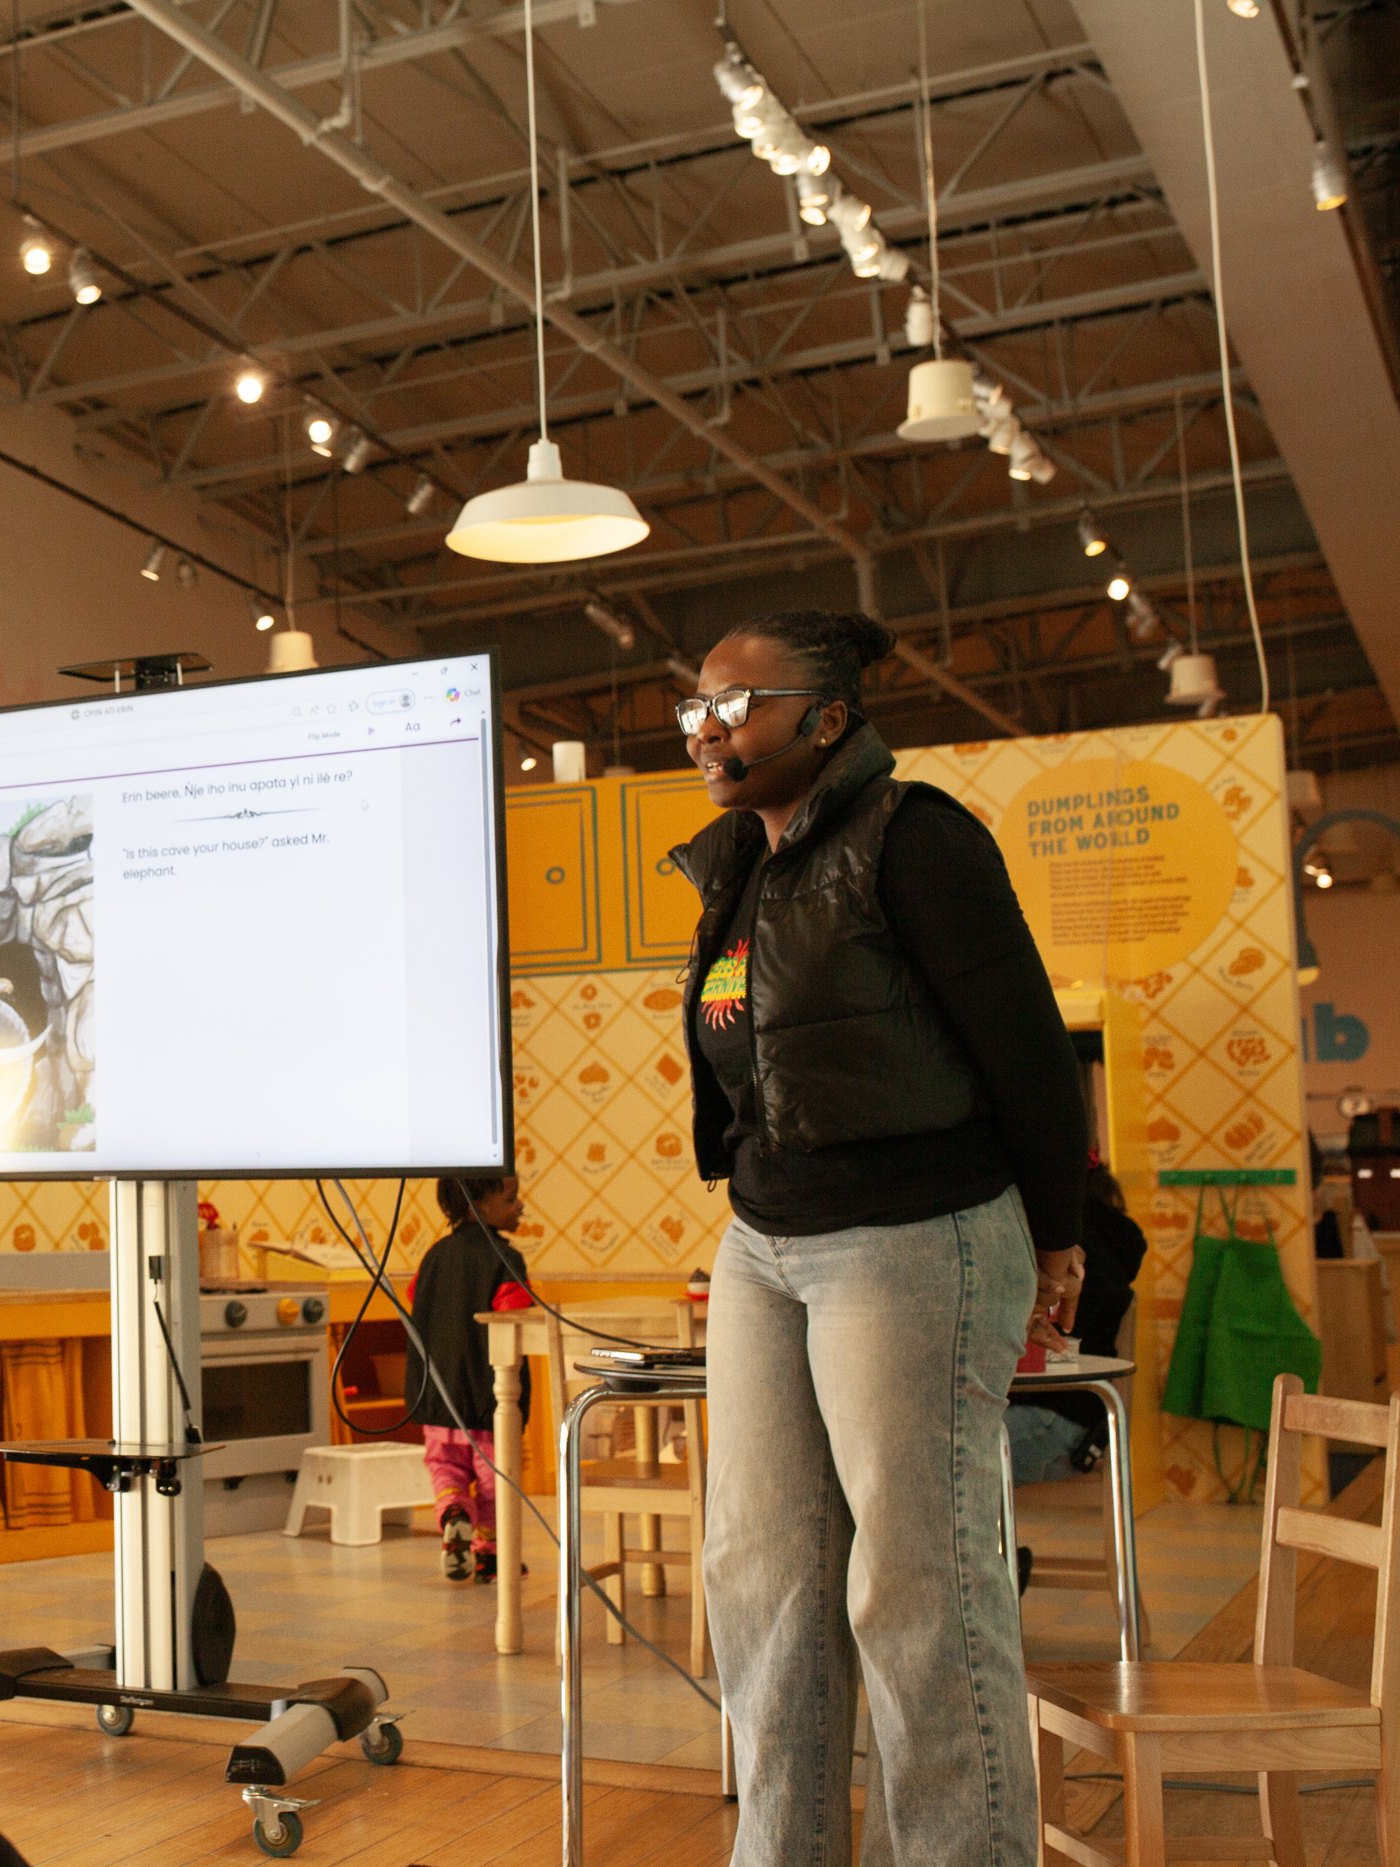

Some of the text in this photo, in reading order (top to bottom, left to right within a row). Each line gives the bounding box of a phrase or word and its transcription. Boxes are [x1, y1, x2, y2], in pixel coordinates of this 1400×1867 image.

[372, 699, 388, 708] Sign
[464, 688, 481, 697] Chat
[321, 730, 341, 739] Mode
[122, 791, 143, 803] Erin
[145, 788, 182, 801] beere,
[206, 782, 226, 795] iho
[228, 780, 247, 793] inu
[249, 778, 287, 793] apata
[302, 772, 314, 785] ni
[1027, 785, 1150, 817] DUMPLINGS
[1028, 803, 1180, 836] FROM AROUND
[138, 846, 158, 859] this
[161, 845, 190, 857] cave
[192, 843, 219, 858] your
[271, 833, 308, 848] asked
[311, 832, 330, 844] Mr.
[1028, 828, 1150, 857] THE WORLD
[122, 865, 177, 882] elephant.
